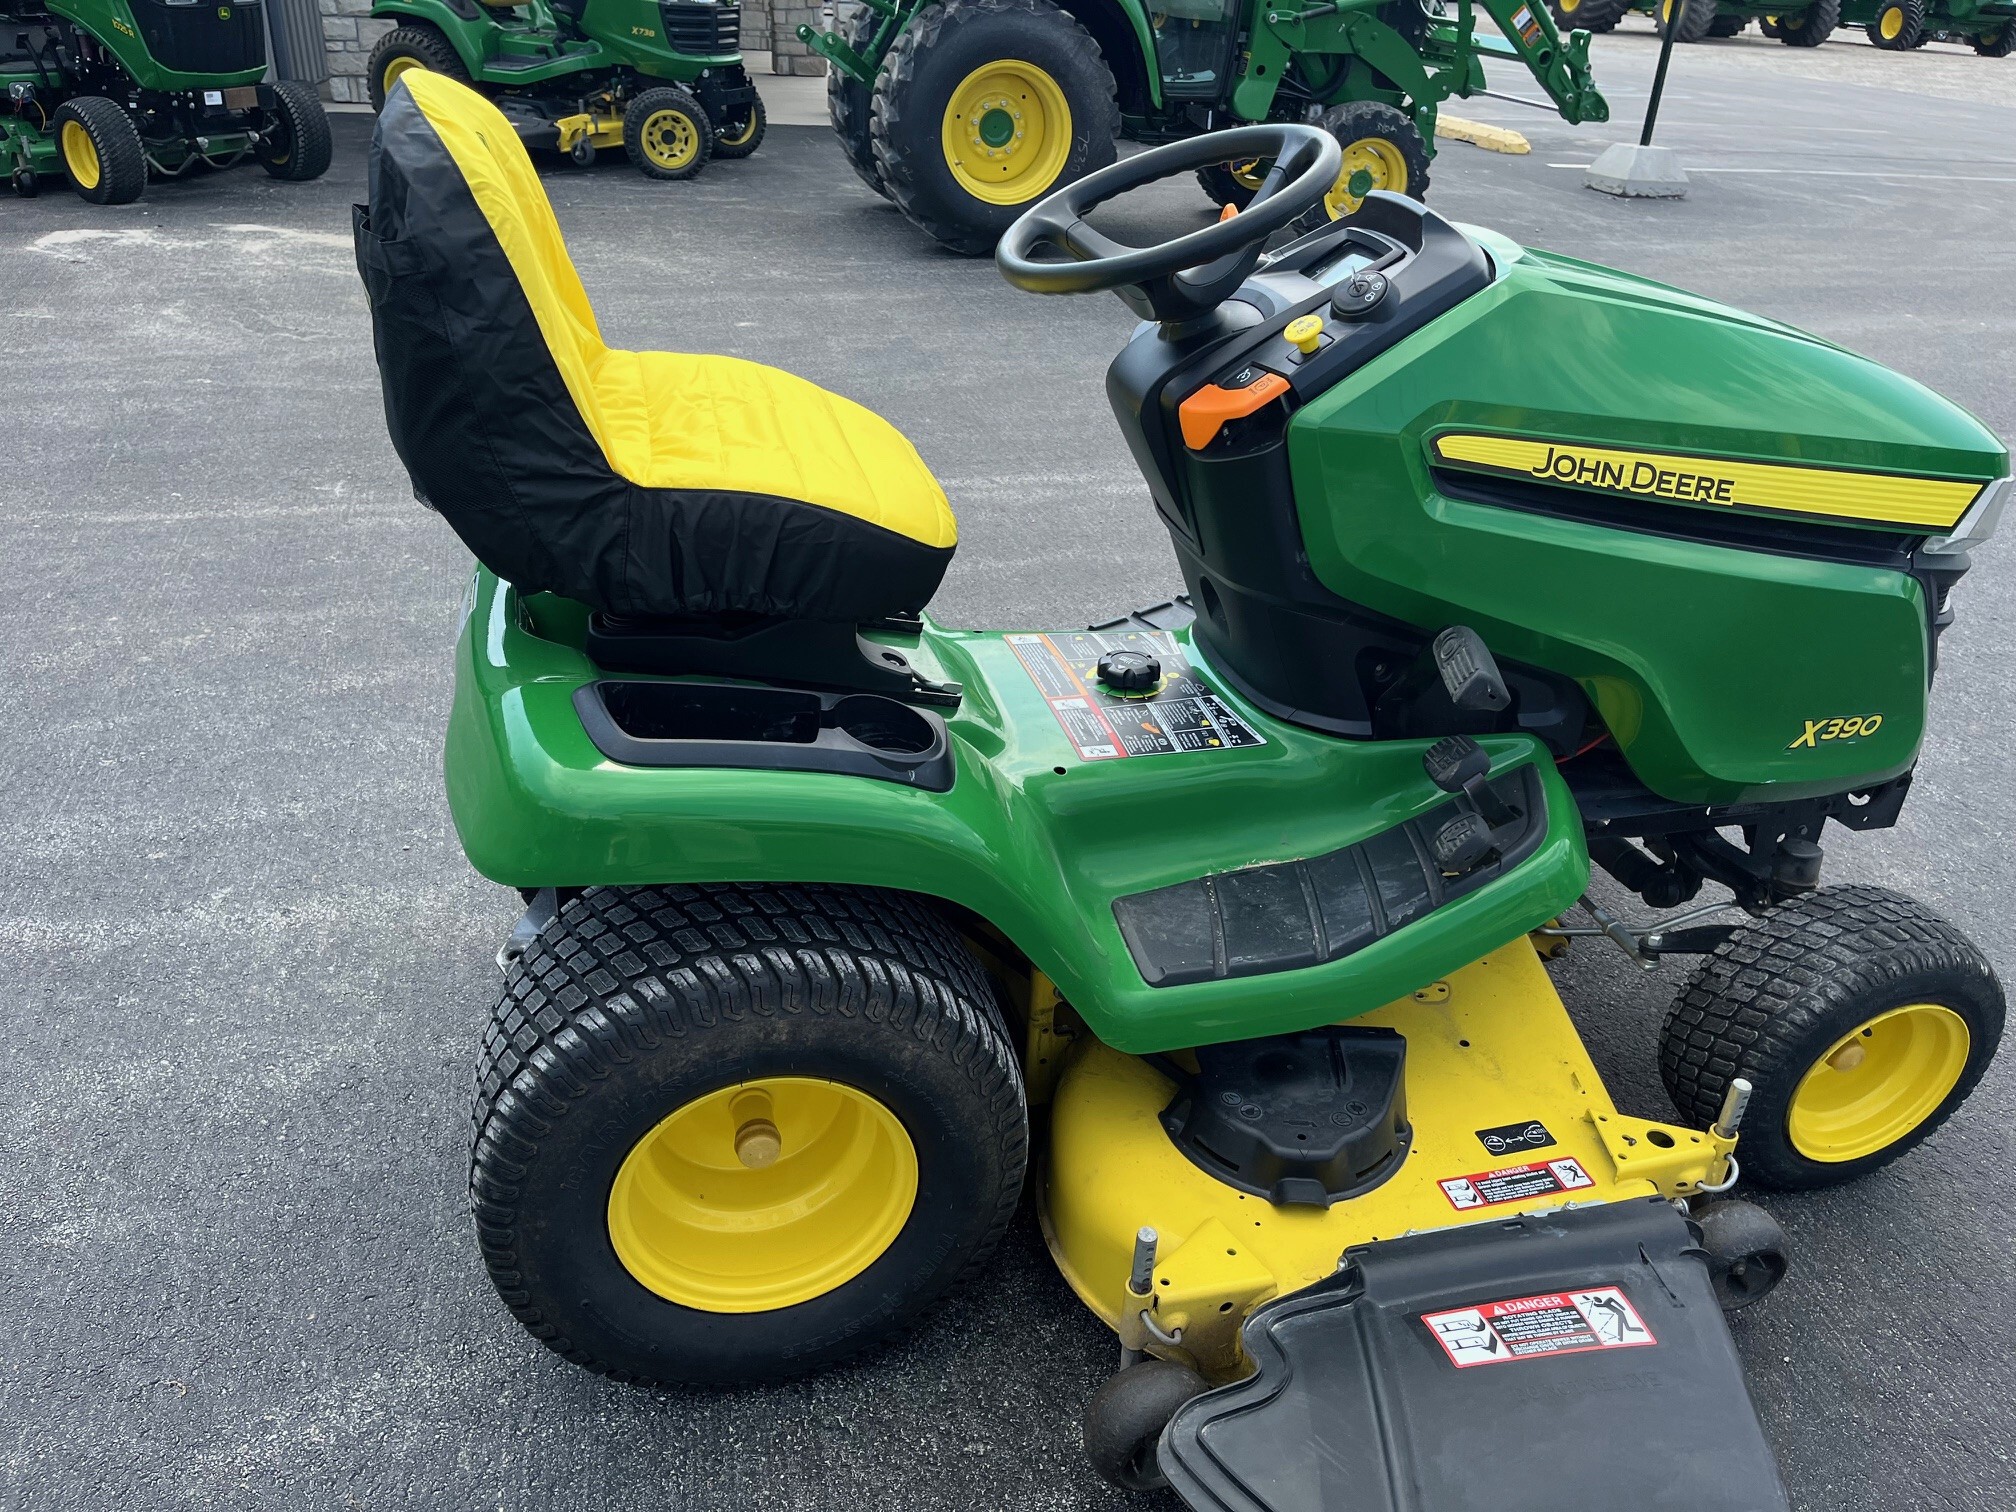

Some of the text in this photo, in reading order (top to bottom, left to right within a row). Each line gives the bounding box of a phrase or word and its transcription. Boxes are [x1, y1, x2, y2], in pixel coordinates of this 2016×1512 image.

[631, 26, 655, 38] X738
[1532, 447, 1735, 502] JOHN DEERE
[1788, 713, 1884, 750] X390
[1494, 1166, 1530, 1176] DANGER
[1505, 1296, 1564, 1312] DANGER
[1502, 1312, 1538, 1320] ROTATING
